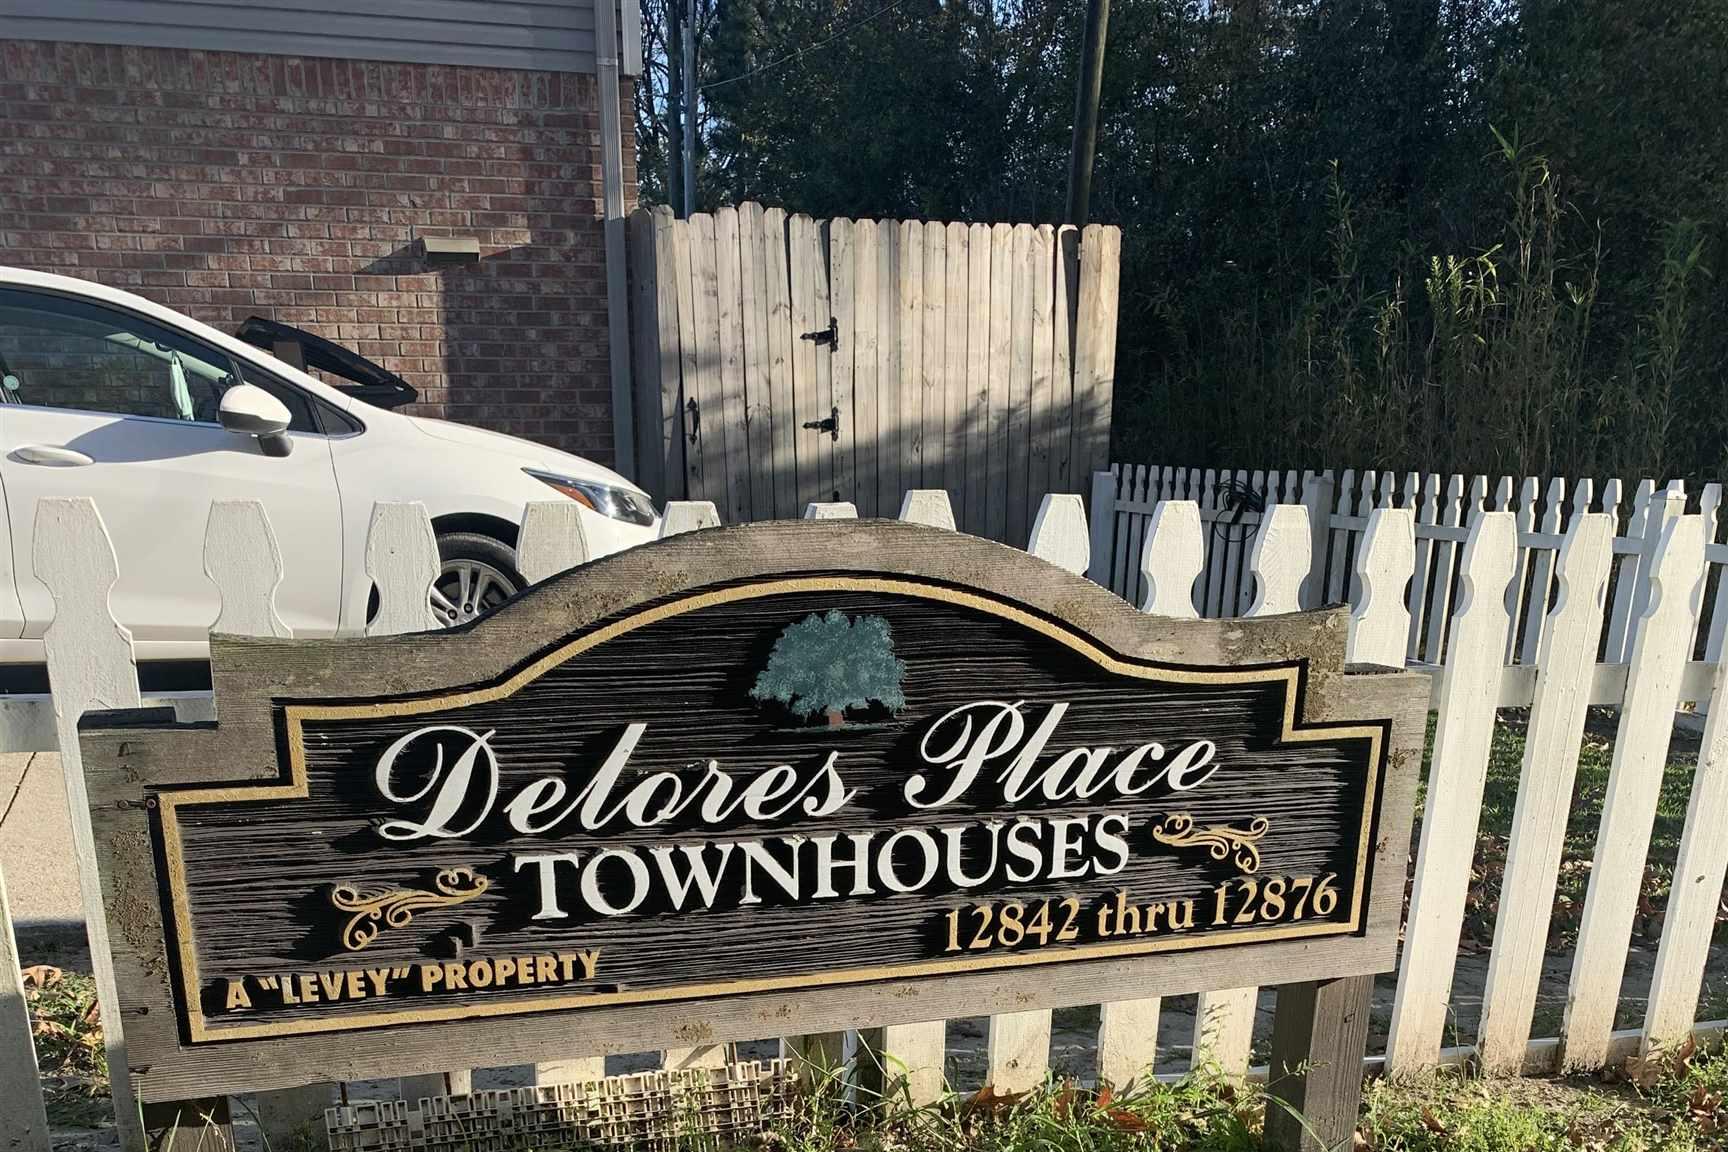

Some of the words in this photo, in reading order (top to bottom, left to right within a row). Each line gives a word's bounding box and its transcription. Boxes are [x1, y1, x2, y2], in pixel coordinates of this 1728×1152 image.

[375, 722, 857, 841] Delores
[903, 700, 1221, 809] Place
[513, 813, 1131, 921] TOWNHOUSES
[943, 898, 1080, 952] 12842
[1097, 886, 1194, 937] thru
[1212, 872, 1339, 928] 12876
[225, 979, 252, 1010] A
[421, 949, 601, 993] PROPERTY
